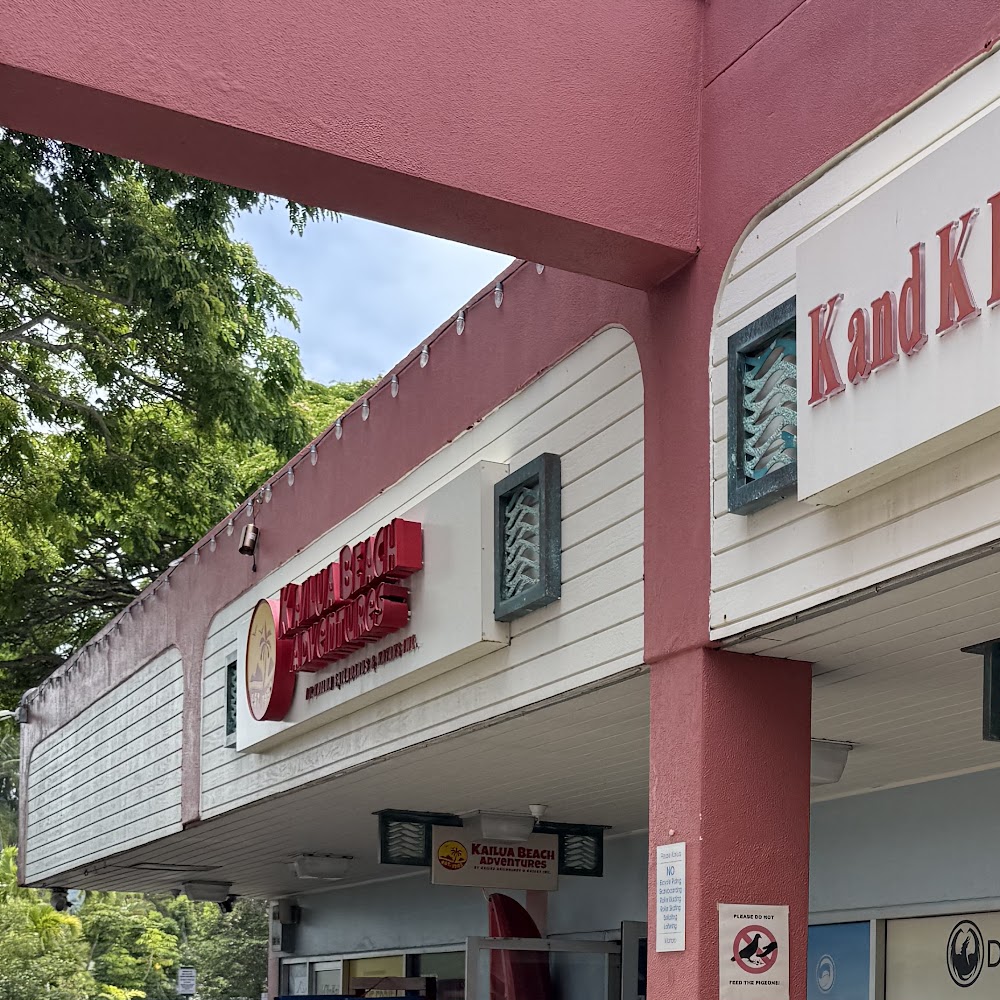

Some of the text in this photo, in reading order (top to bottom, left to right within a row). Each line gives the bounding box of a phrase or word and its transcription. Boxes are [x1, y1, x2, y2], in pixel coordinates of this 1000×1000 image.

[807, 293, 846, 406] K
[846, 241, 928, 386] and
[936, 207, 981, 336] K
[278, 517, 421, 640] KAILUA BEACH
[471, 843, 555, 861] KAILUA BEACH
[666, 866, 675, 876] NO
